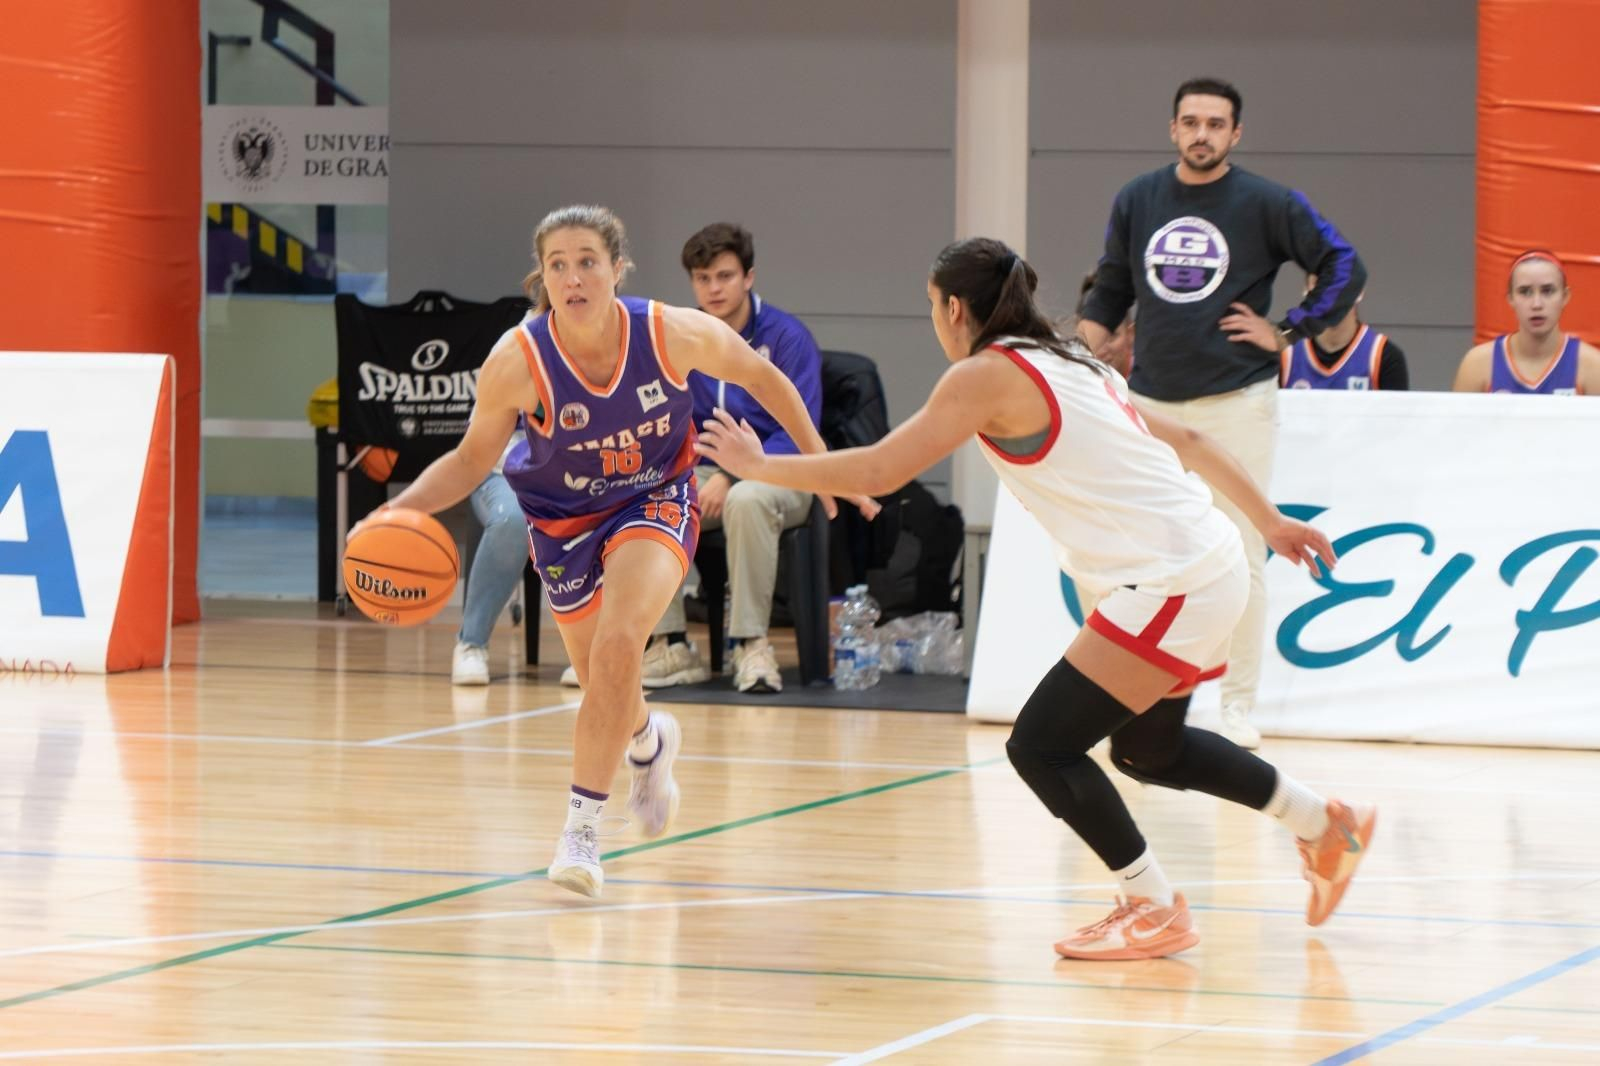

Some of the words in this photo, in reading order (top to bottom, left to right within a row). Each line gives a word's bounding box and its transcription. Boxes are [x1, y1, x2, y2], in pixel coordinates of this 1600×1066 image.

[304, 160, 332, 176] DE
[337, 157, 389, 177] GRA
[1164, 231, 1209, 255] G
[394, 404, 415, 415] TRUE
[417, 404, 429, 415] TO
[430, 404, 445, 414] THE
[446, 402, 469, 414] GAME
[600, 440, 643, 477] 16
[640, 501, 683, 530] 16
[355, 569, 427, 601] Wilson
[1276, 522, 1475, 670] El
